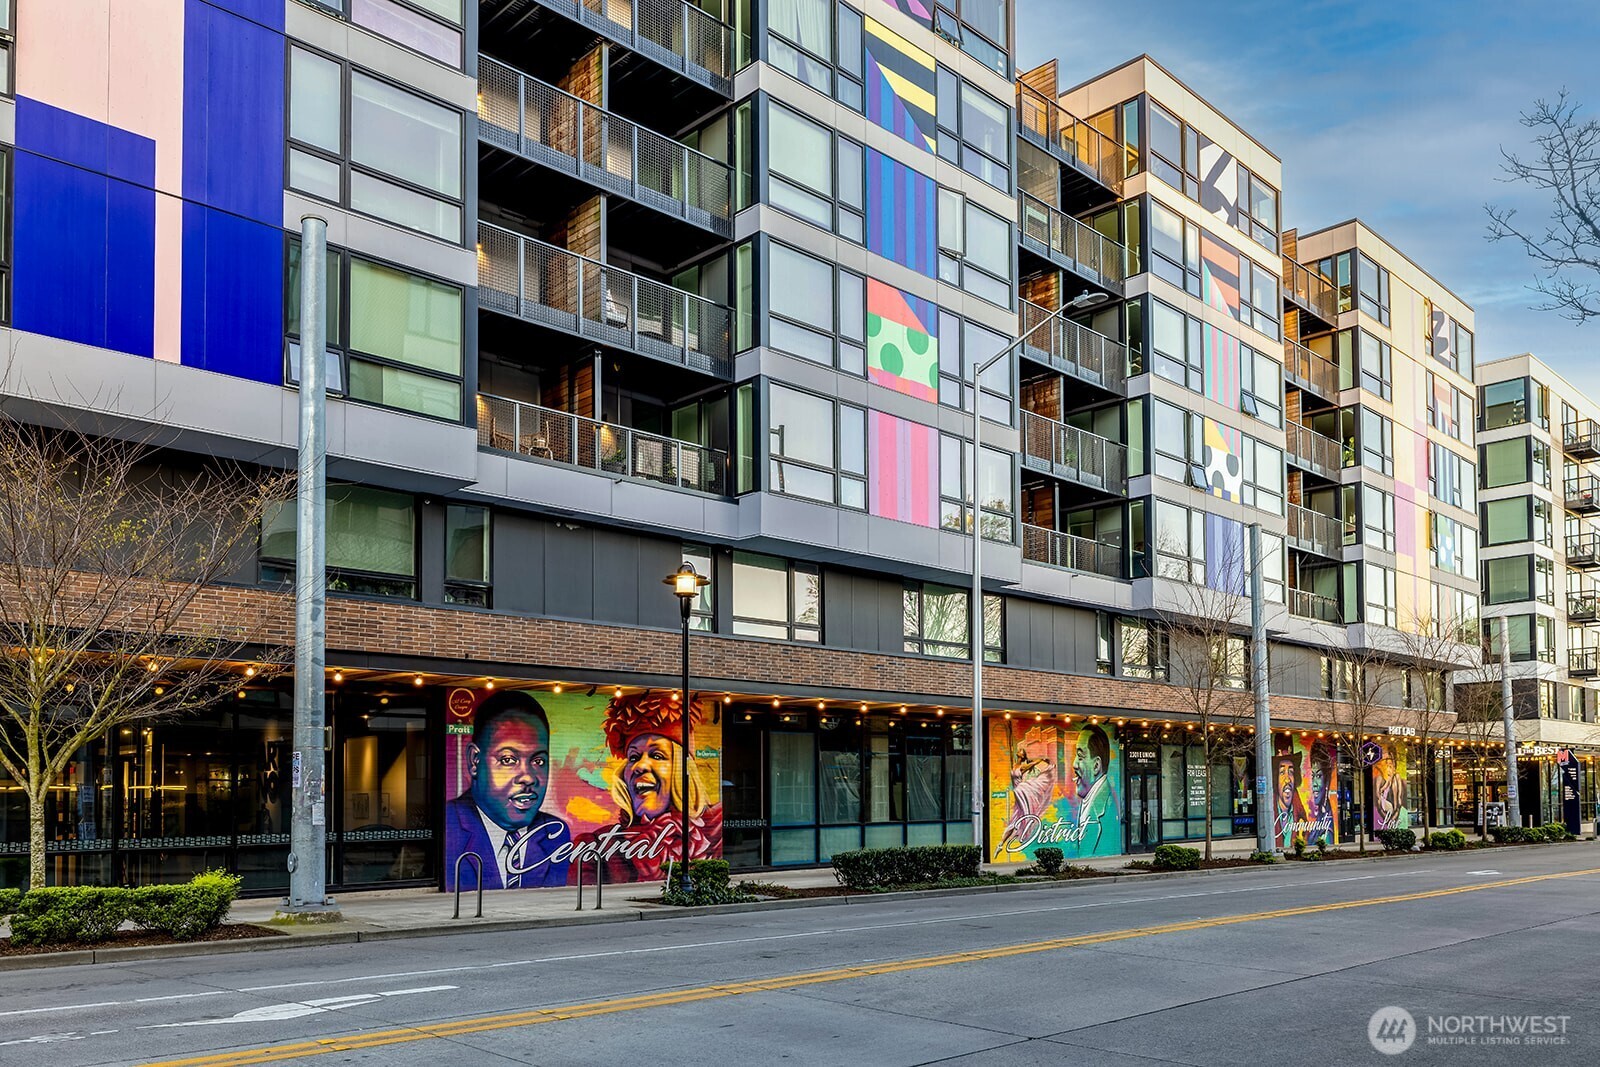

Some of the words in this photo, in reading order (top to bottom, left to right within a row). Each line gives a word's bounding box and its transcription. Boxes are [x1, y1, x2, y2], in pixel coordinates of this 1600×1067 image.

[449, 725, 471, 734] Pratt
[1534, 746, 1561, 756] BEST
[1006, 814, 1099, 853] District
[1273, 812, 1332, 840] Community
[506, 820, 676, 875] Central
